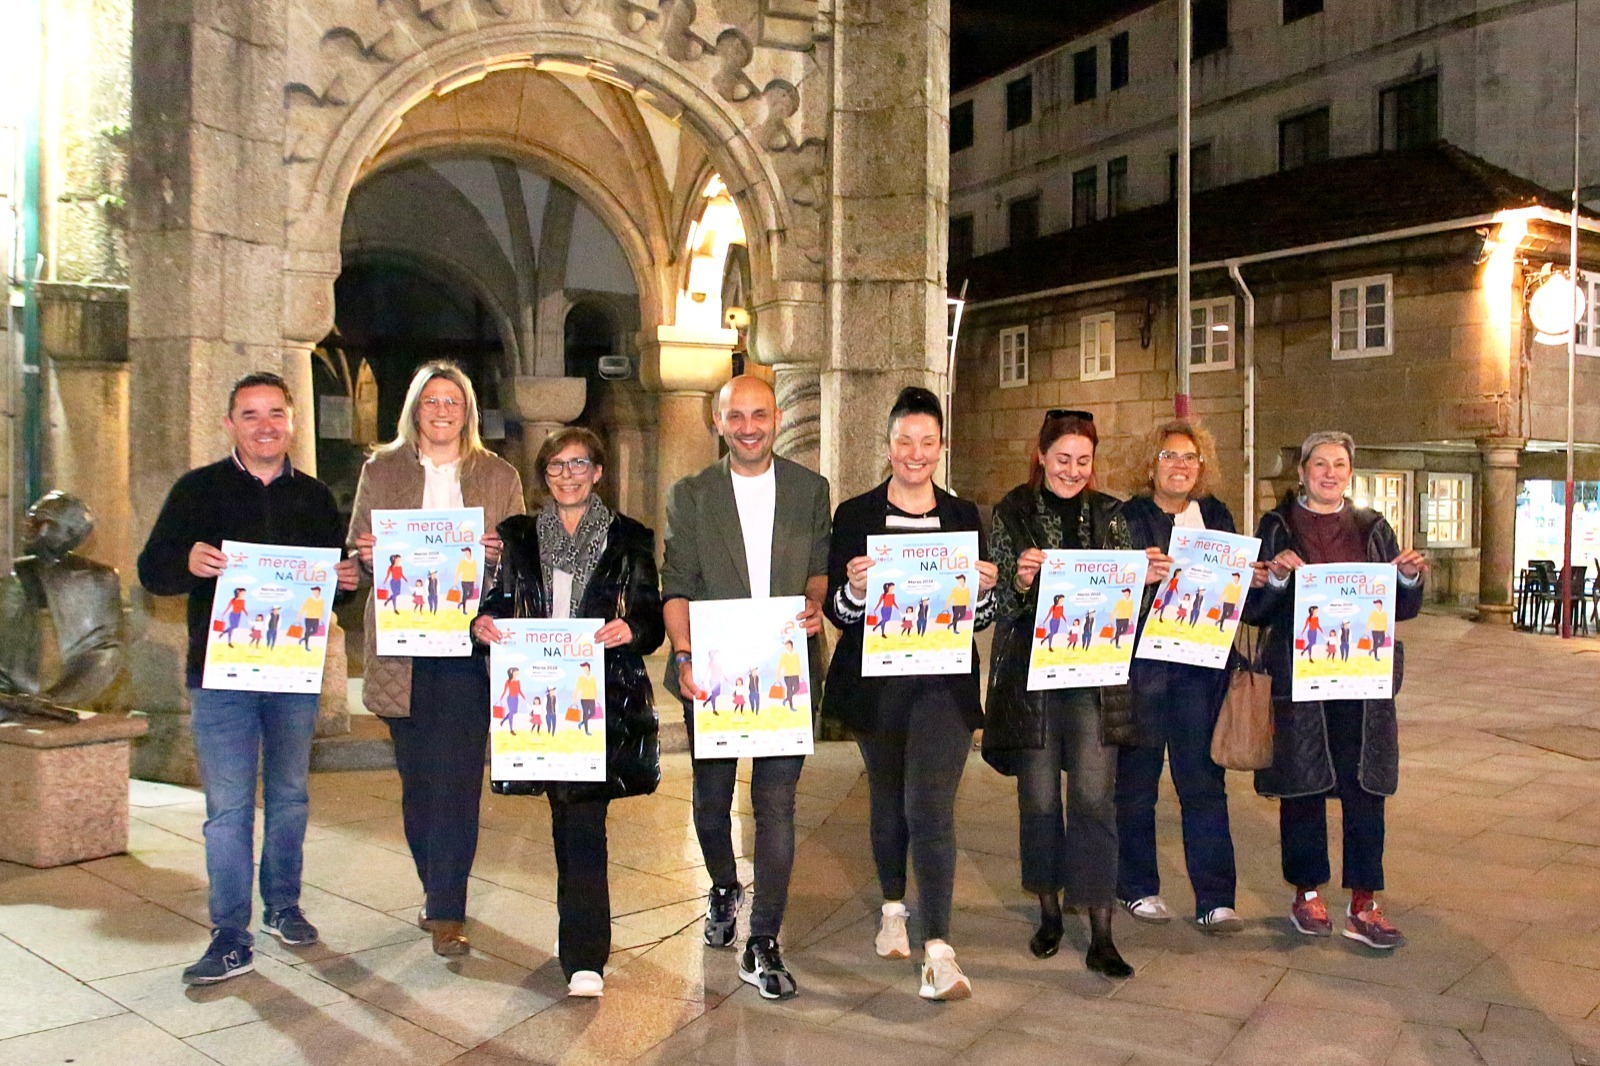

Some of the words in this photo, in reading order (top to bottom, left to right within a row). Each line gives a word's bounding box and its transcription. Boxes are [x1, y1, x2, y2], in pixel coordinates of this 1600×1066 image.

[407, 522, 453, 532] merca
[426, 535, 443, 544] NA
[1194, 540, 1231, 554] merca
[903, 547, 948, 558] merca
[258, 557, 307, 569] merca
[1203, 553, 1218, 564] NA
[921, 561, 938, 571] NA
[1075, 563, 1118, 573] merca
[276, 571, 294, 581] NA
[1090, 576, 1106, 585] NA
[1325, 574, 1367, 584] merca
[1341, 587, 1357, 596] NA
[526, 633, 572, 643] merca
[544, 647, 562, 657] NA
